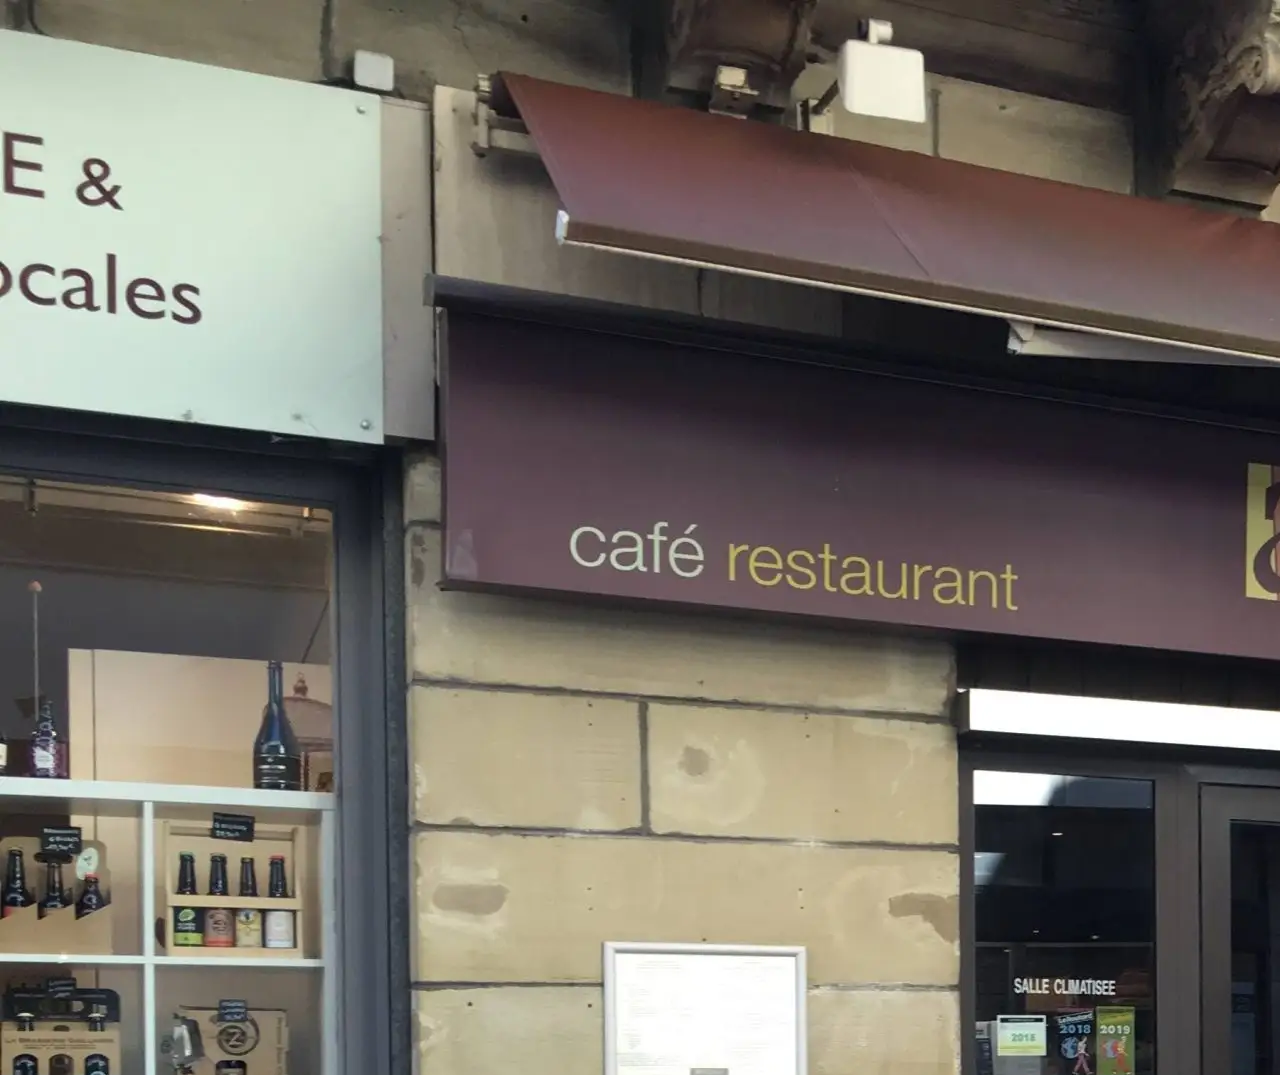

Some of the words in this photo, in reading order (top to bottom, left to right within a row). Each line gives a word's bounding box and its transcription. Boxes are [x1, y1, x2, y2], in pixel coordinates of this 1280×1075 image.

[4, 131, 45, 199] E
[75, 157, 124, 211] &
[569, 521, 704, 578] café
[728, 543, 1018, 610] restaurant
[1013, 978, 1050, 994] SALLE
[1053, 978, 1116, 996] CLIMATISEE
[1060, 1024, 1091, 1034] 2018
[1100, 1025, 1130, 1034] 2019
